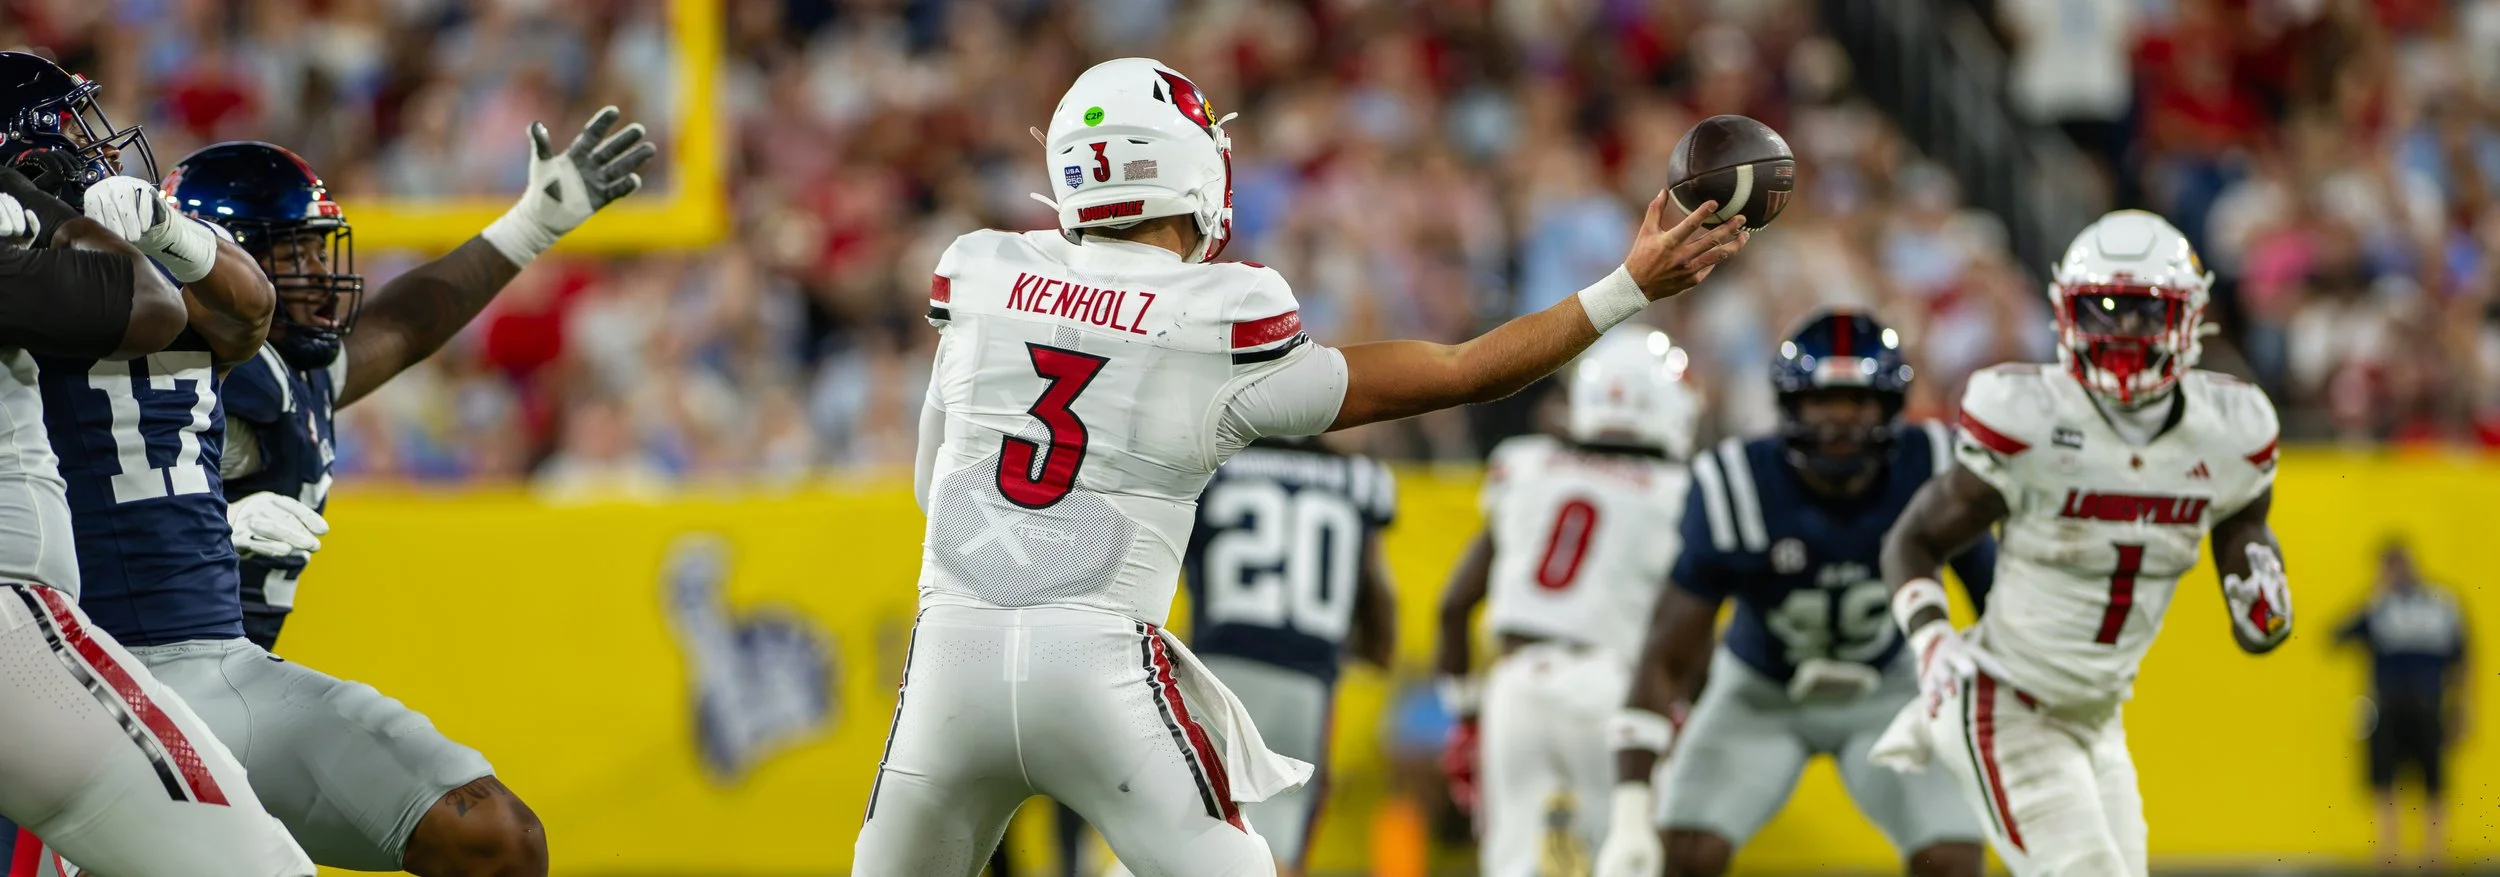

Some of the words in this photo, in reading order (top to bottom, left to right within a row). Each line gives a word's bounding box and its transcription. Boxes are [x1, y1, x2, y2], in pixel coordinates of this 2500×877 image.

[1085, 111, 1103, 121] C2P
[1066, 177, 1083, 185] 250
[1089, 141, 1111, 183] 3
[1077, 200, 1145, 223] LOUISVILLE
[1006, 272, 1156, 336] KIENHOLZ
[88, 351, 217, 504] 17
[995, 341, 1111, 510] 3
[2060, 488, 2210, 524] LOUISVILLE
[1203, 480, 1363, 642] 20
[1536, 498, 1599, 590] 0
[2094, 543, 2146, 646] 1
